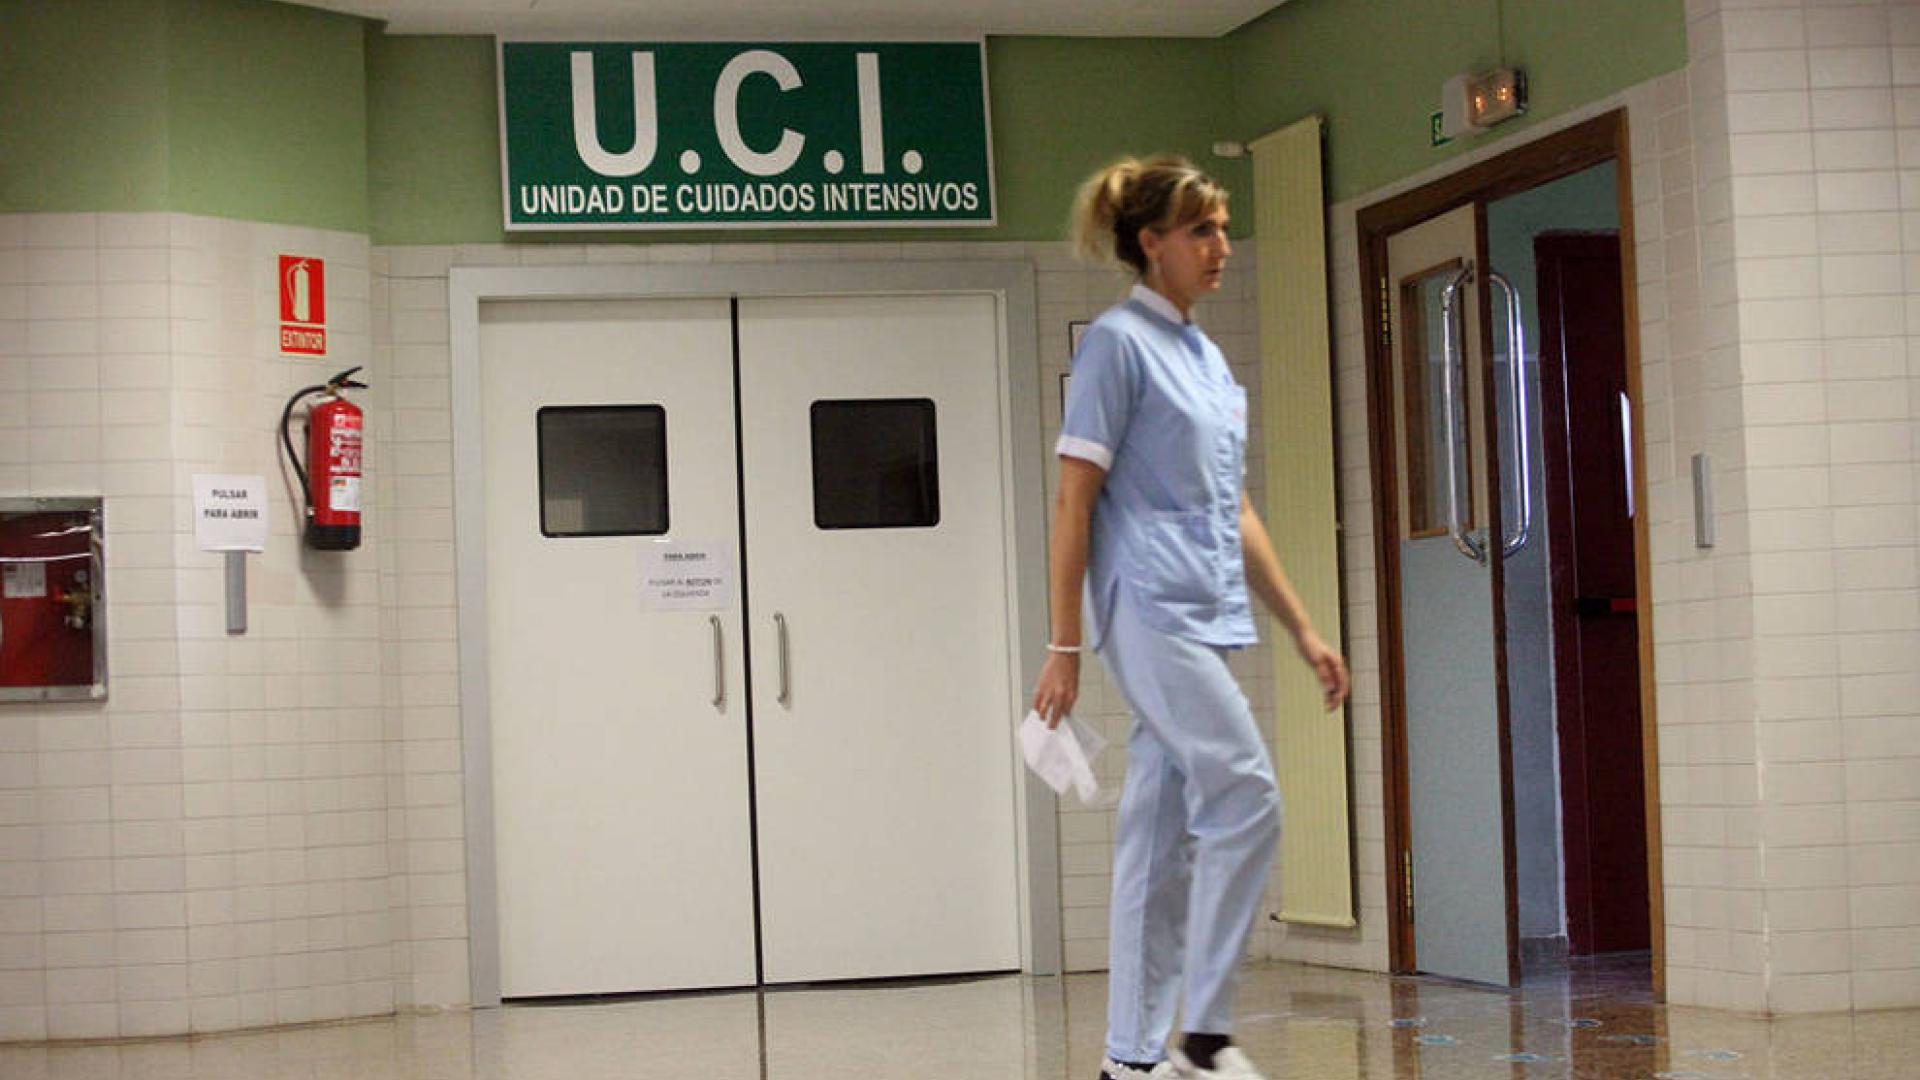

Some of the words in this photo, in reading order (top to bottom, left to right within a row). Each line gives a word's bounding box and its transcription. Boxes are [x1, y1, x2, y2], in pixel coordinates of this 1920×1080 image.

[570, 49, 924, 177] U.C.I.
[521, 184, 624, 214] UNIDAD
[631, 184, 669, 213] DE
[676, 183, 816, 212] CUIDADOS
[823, 182, 979, 211] INTENSIVOS
